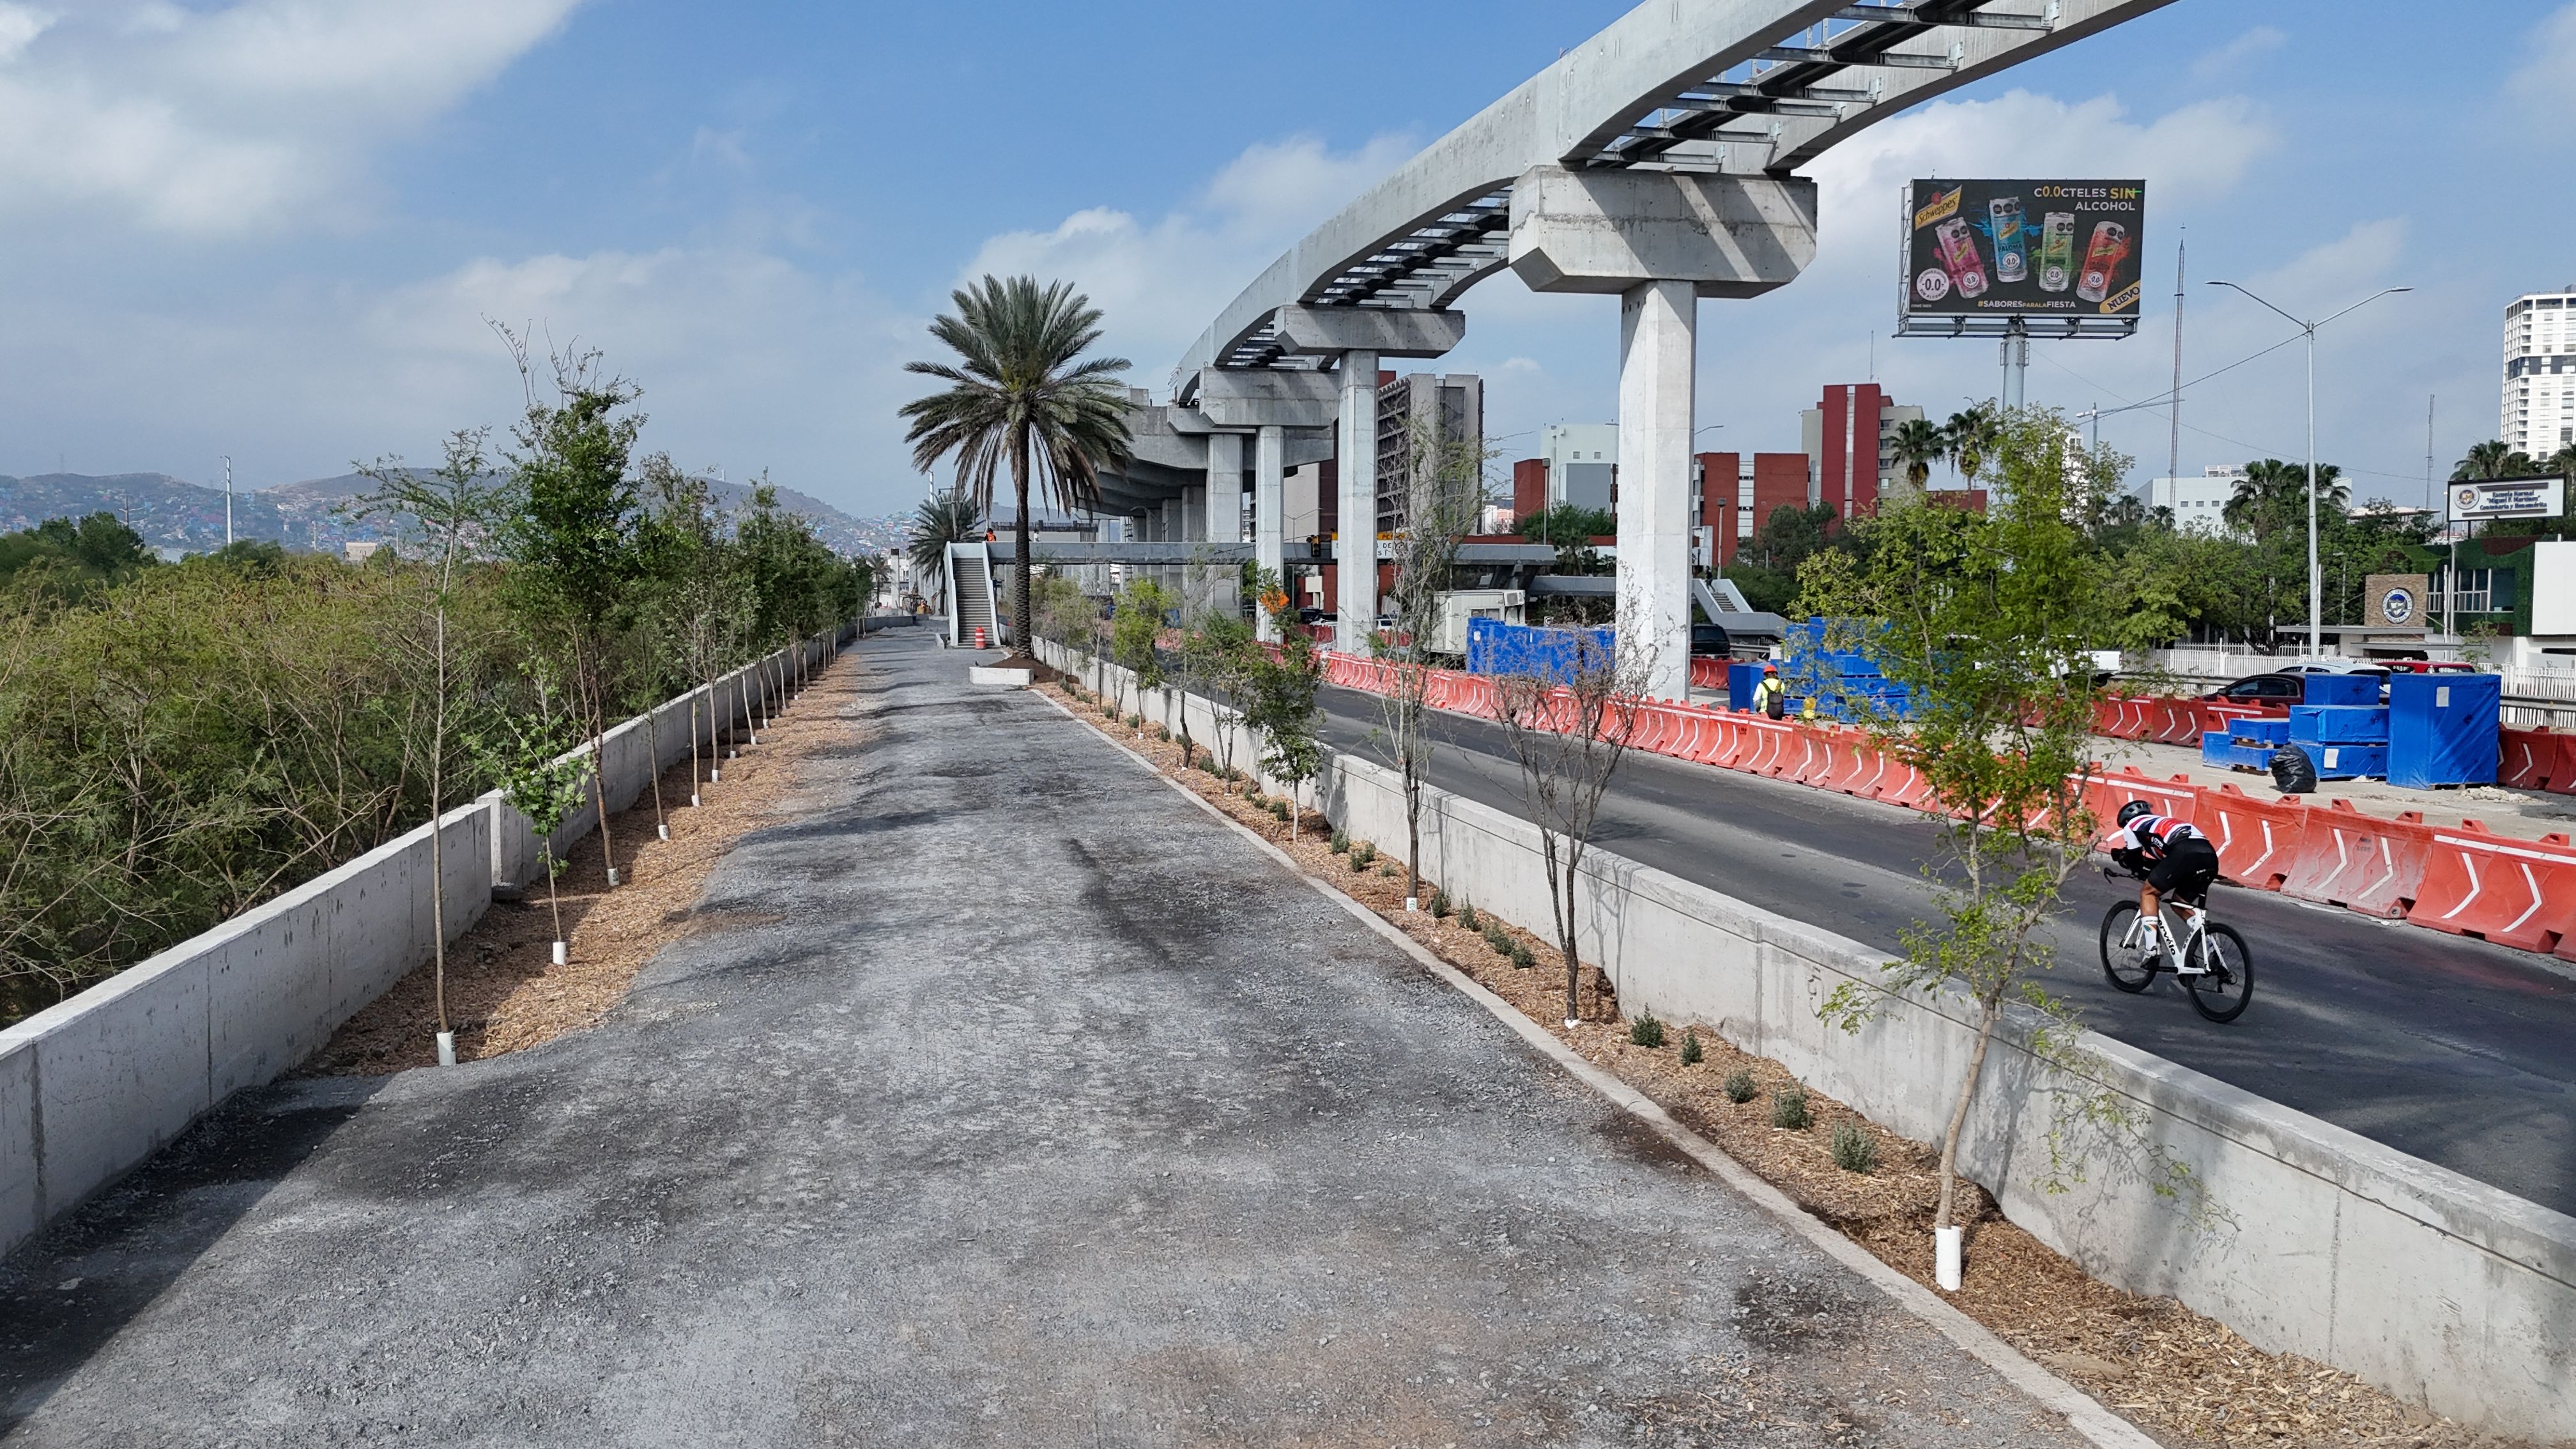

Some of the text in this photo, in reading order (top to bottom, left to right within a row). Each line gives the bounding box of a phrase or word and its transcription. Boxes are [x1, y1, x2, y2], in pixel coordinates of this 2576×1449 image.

[2034, 185, 2135, 199] C0.0CTELES SIN
[1918, 198, 1956, 225] Schweppes
[2075, 201, 2135, 211] ALCOHOL
[2107, 287, 2140, 310] NUEVO
[2158, 919, 2175, 955] ervélo
